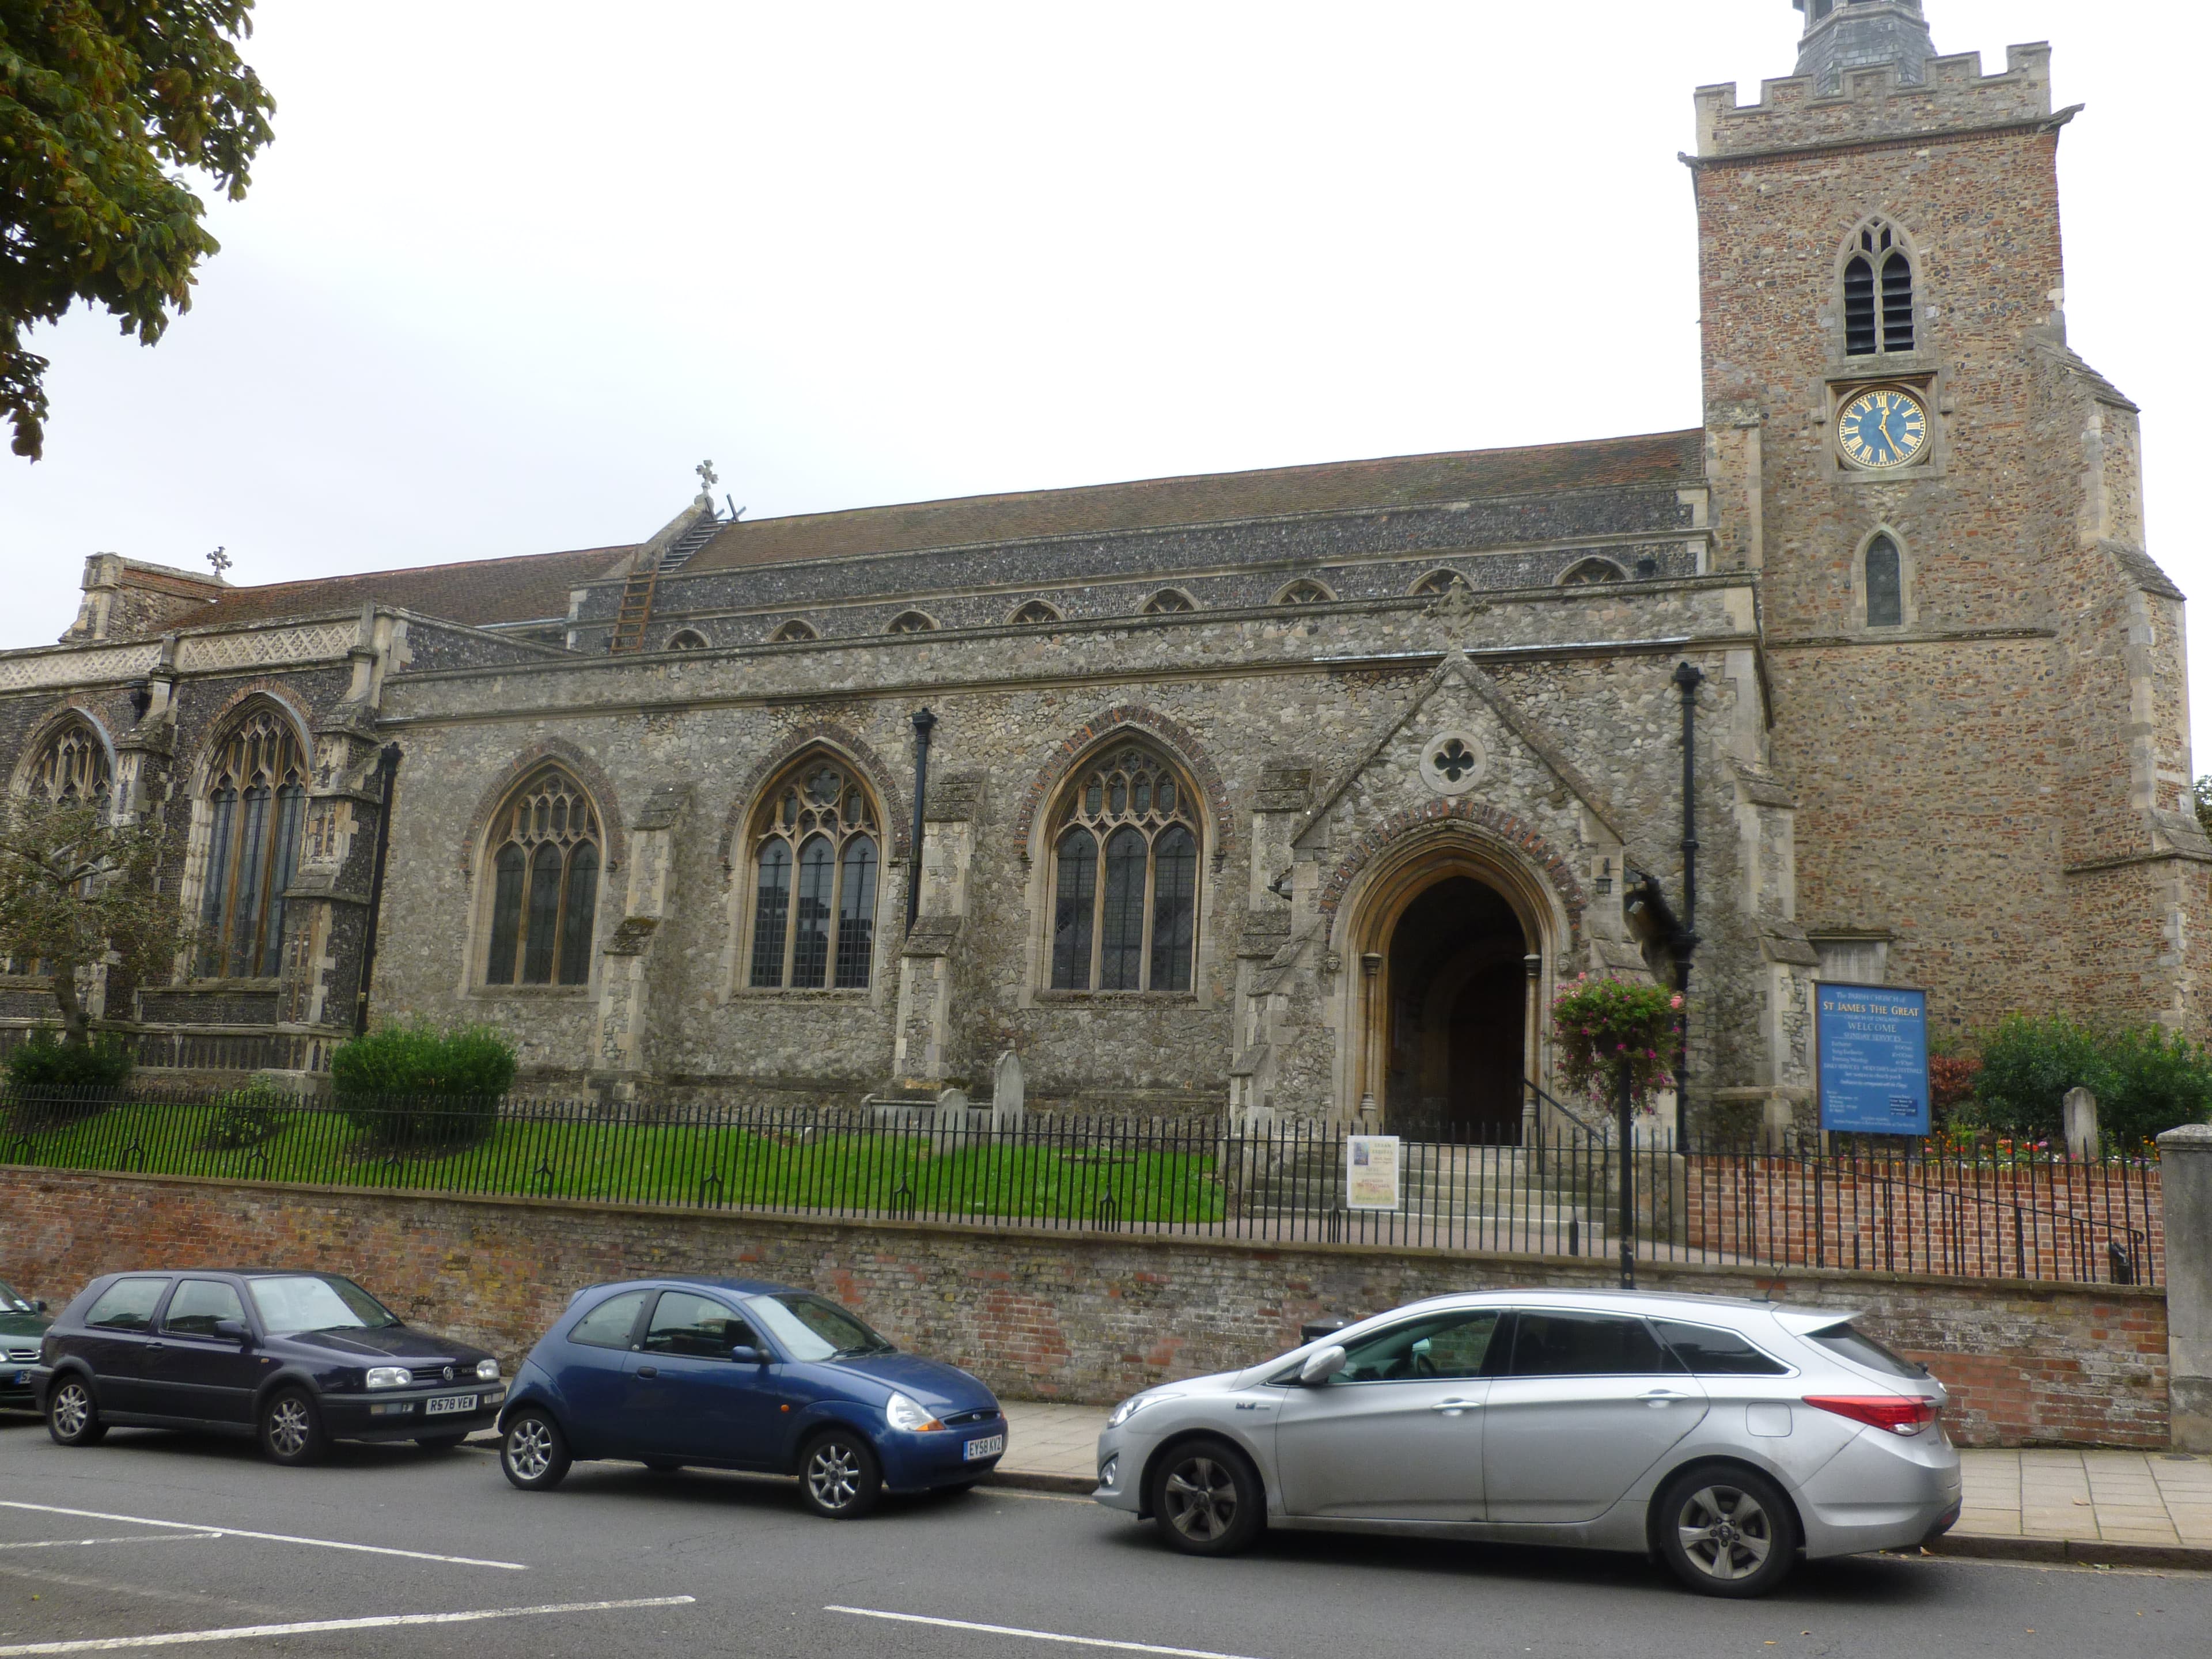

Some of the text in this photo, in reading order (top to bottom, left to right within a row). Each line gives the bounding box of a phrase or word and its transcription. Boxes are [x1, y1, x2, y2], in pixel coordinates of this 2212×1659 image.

[1823, 1001, 1919, 1017] ST JAMES THE GREAT
[1847, 1022, 1897, 1033] WELCOME
[1843, 1032, 1902, 1042] SUNDAY SERVICES
[431, 1396, 474, 1411] R578 VEW
[969, 1437, 1001, 1456] EY58 KVZ
